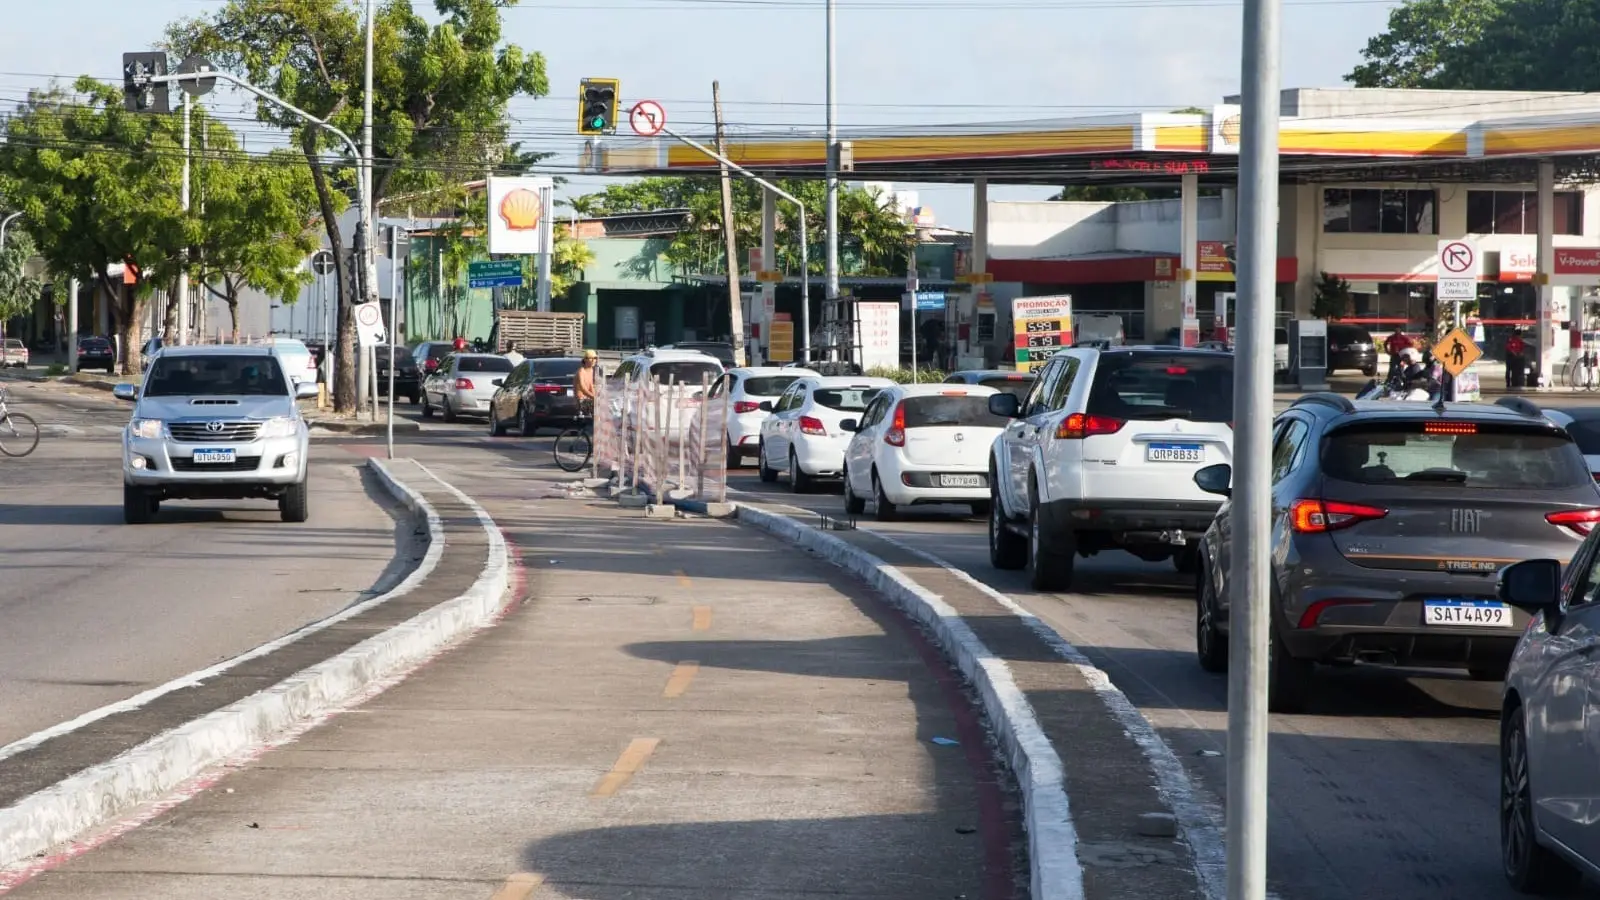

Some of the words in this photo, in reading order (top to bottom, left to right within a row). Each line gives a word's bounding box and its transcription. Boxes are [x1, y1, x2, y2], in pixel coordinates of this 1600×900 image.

[1559, 256, 1600, 267] V-Power
[1452, 508, 1483, 532] FIAT
[1446, 560, 1496, 570] TREKKING
[1434, 606, 1503, 623] SAT4A99
